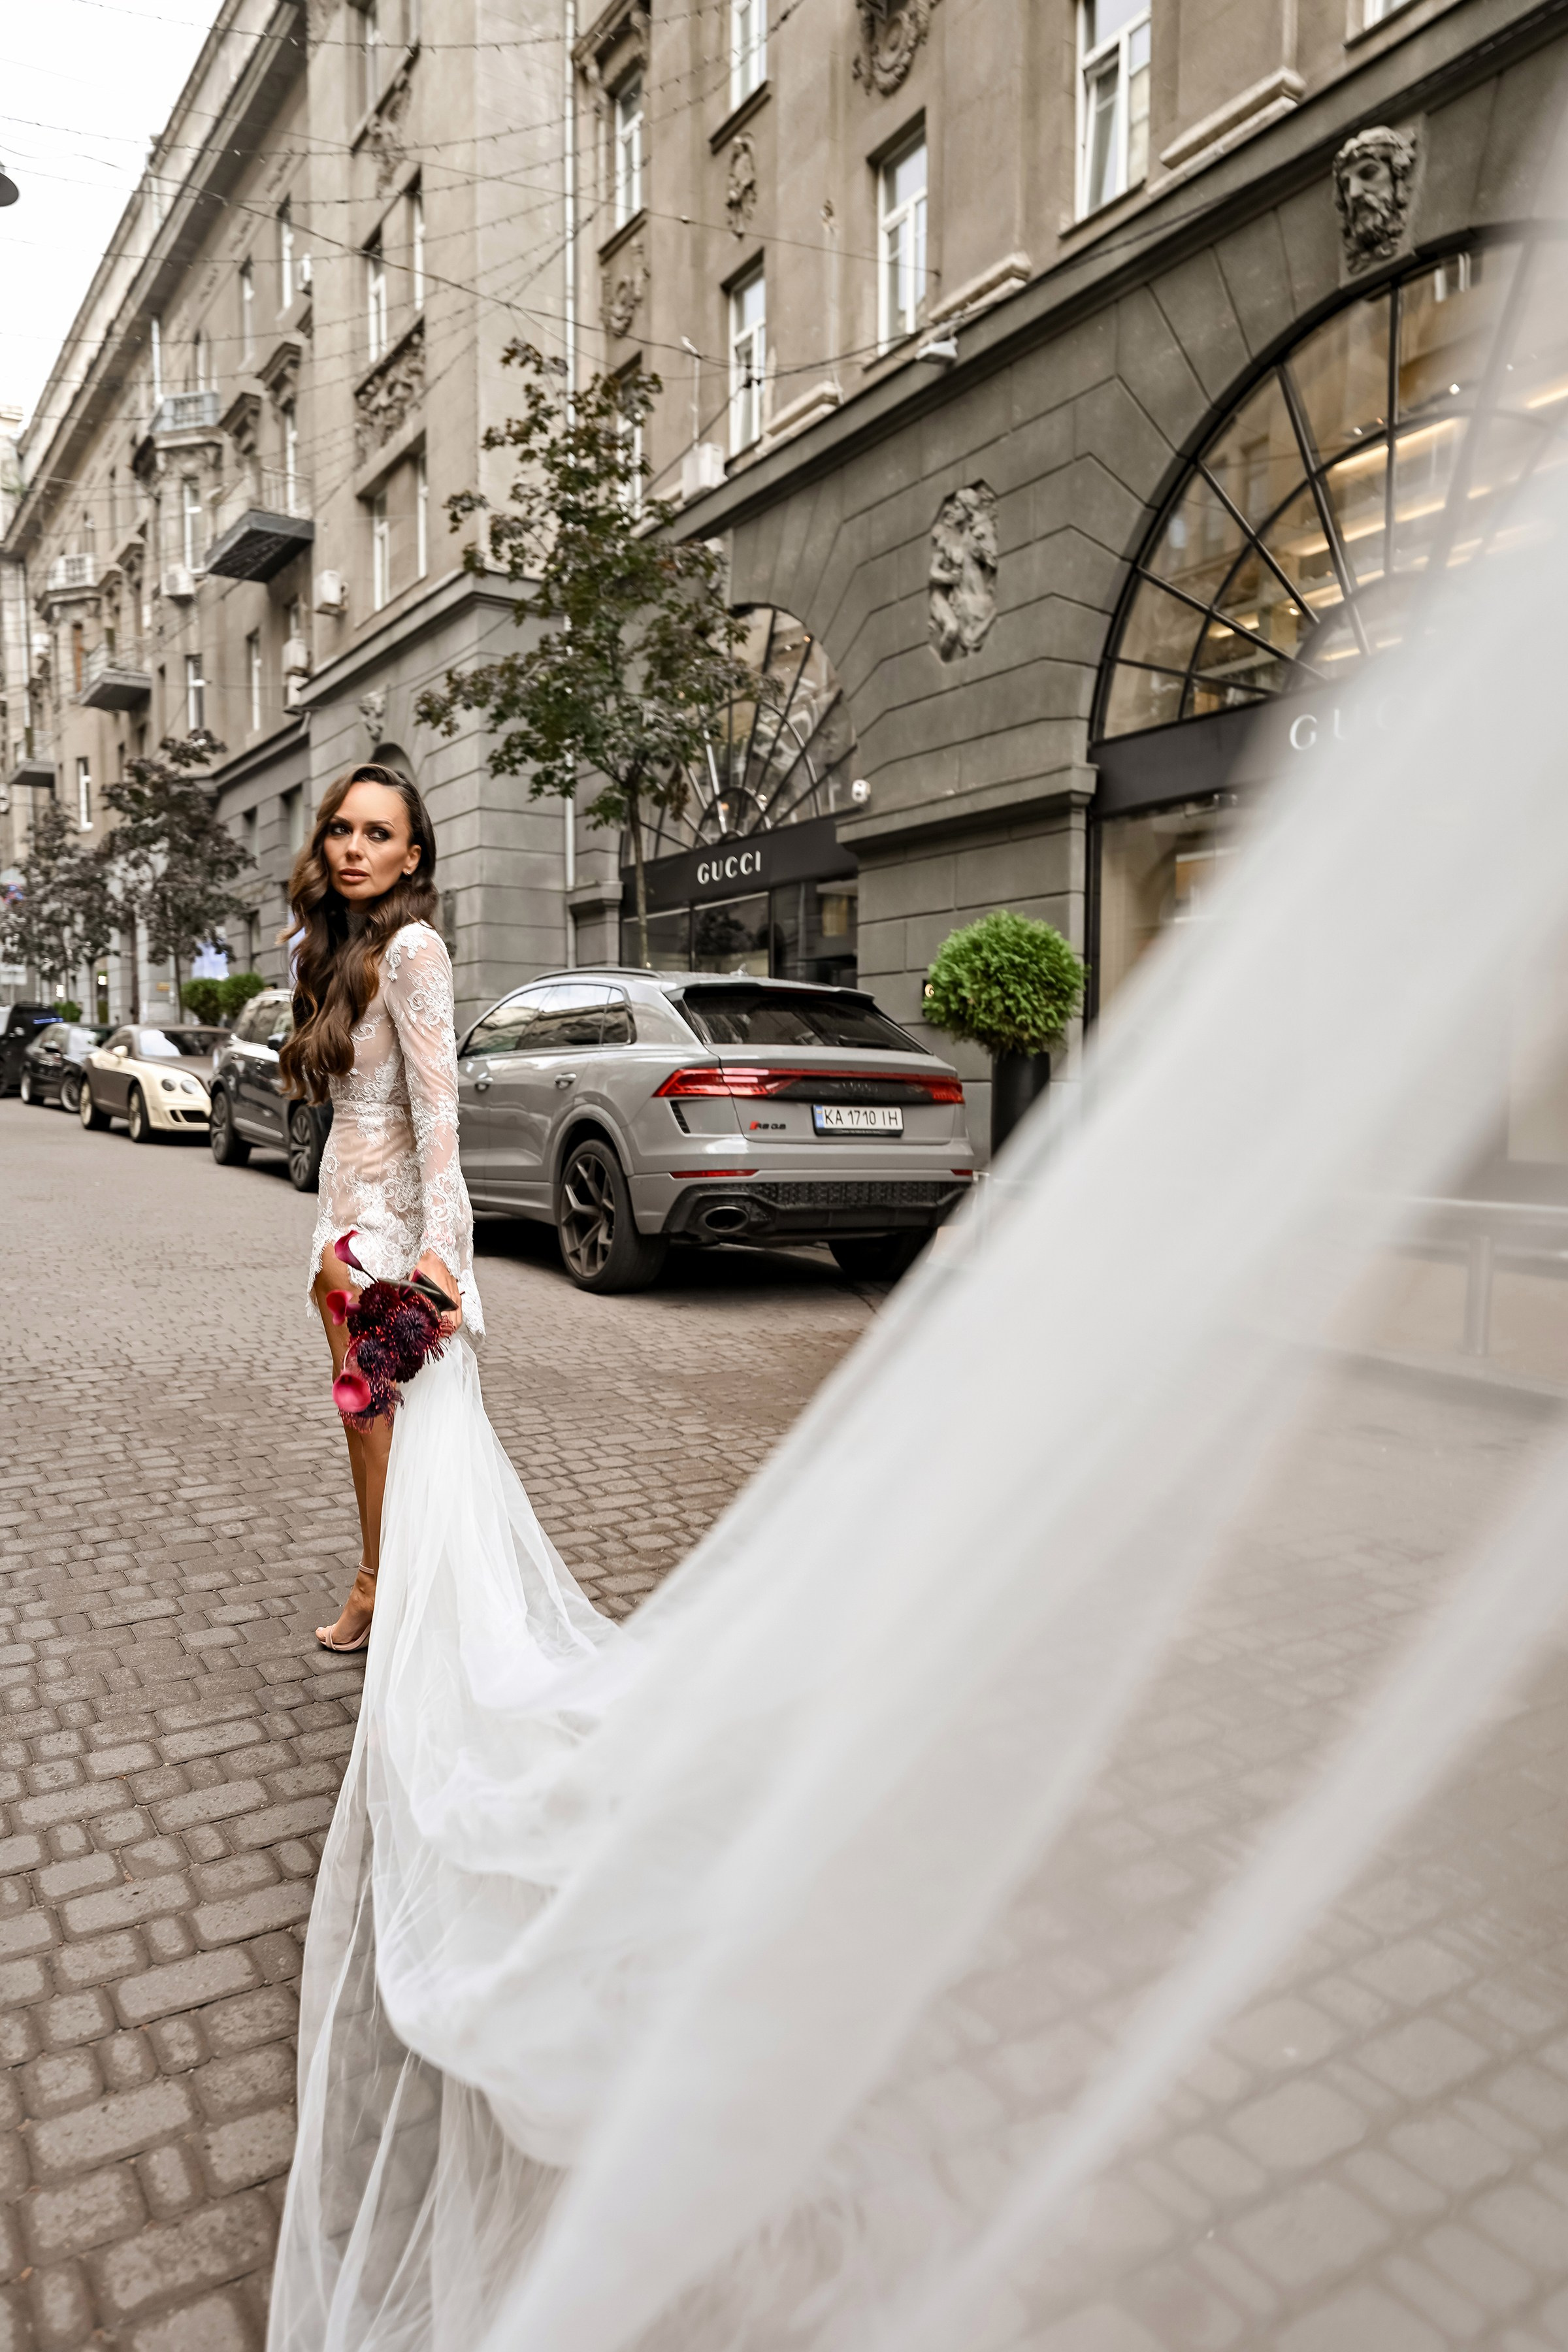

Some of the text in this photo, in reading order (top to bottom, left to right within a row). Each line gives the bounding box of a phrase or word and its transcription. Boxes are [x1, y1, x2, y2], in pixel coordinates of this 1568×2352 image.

[696, 850, 761, 885] GUCCI
[825, 1109, 898, 1126] KA 1710 IH
